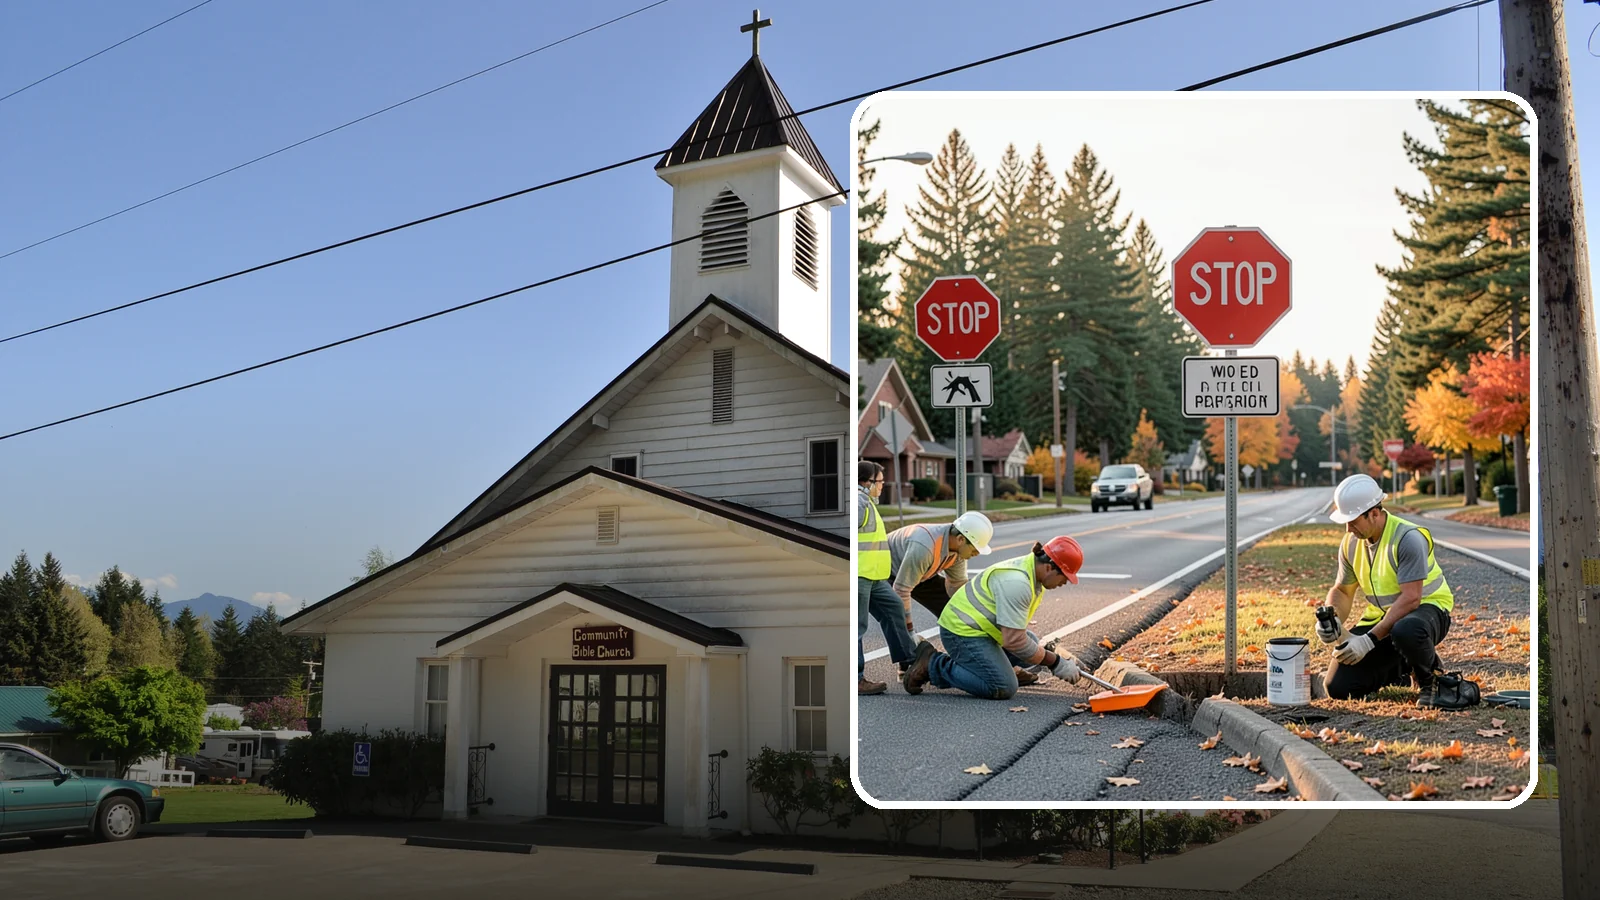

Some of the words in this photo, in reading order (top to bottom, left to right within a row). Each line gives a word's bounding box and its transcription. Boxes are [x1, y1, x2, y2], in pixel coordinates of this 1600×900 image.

[1190, 261, 1277, 305] STOP
[927, 302, 990, 335] STOP
[574, 627, 628, 641] Community
[572, 645, 595, 657] Bible
[597, 645, 631, 658] Church
